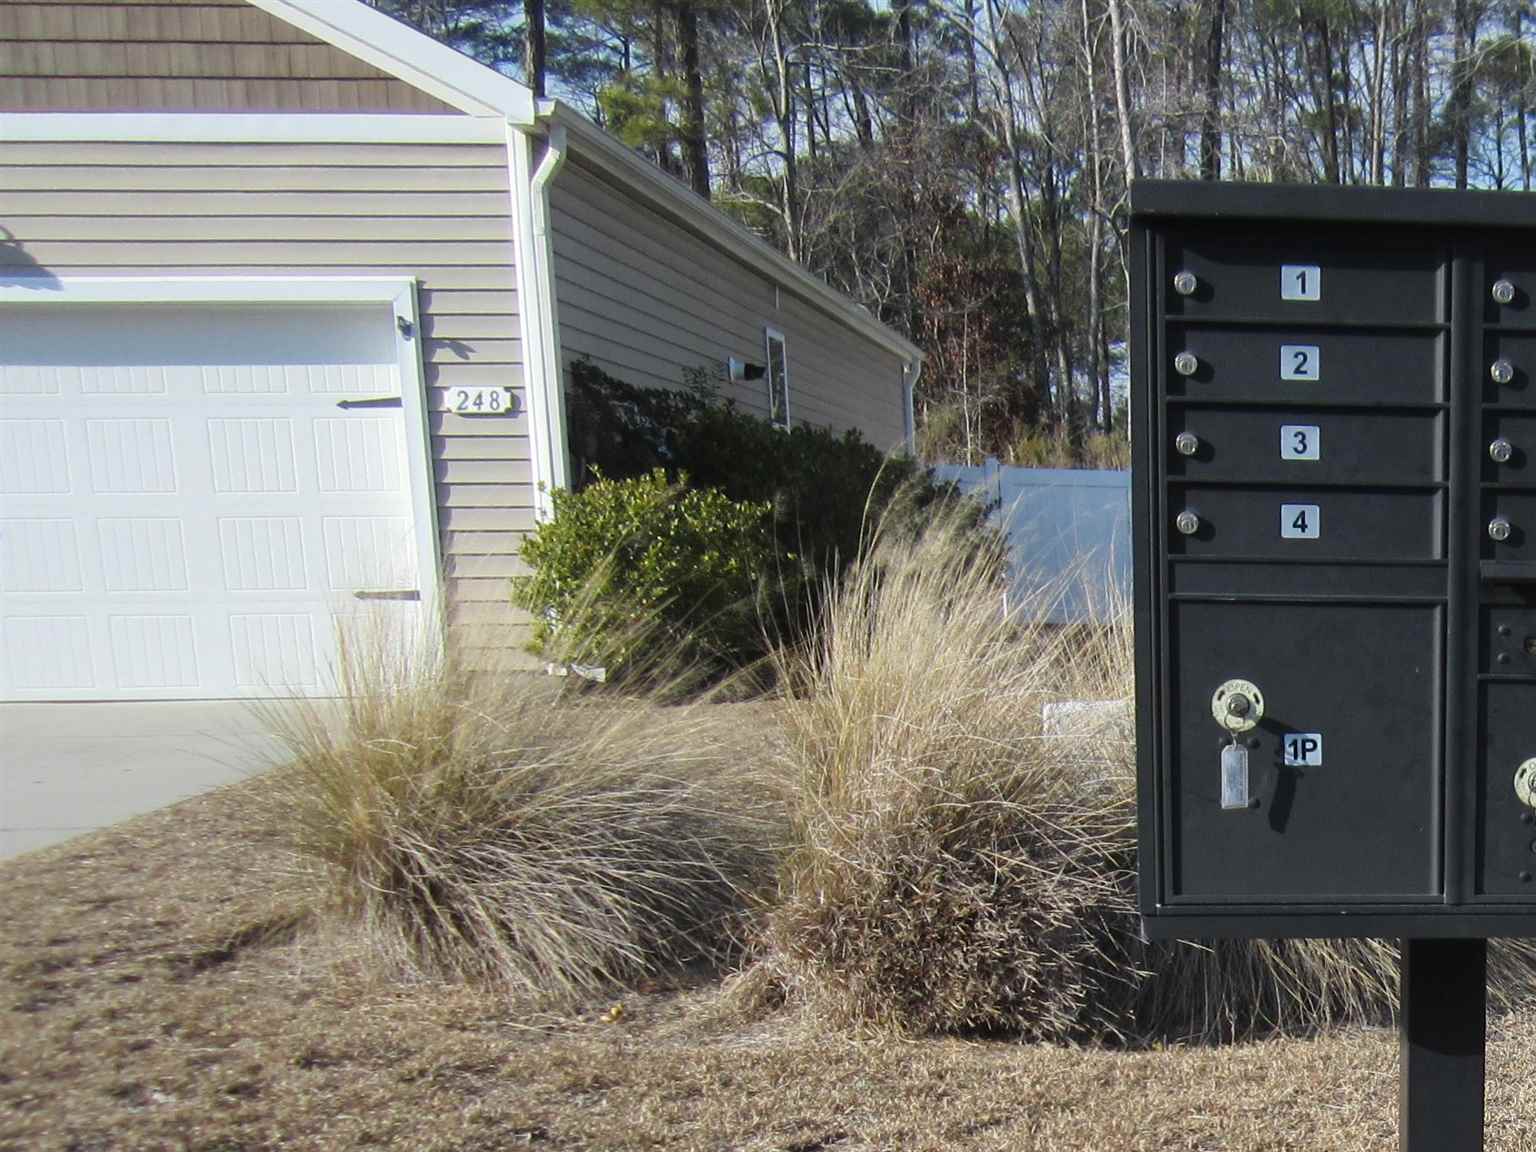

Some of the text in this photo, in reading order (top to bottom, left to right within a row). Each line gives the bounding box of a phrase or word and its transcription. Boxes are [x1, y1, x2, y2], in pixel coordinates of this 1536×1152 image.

[1295, 270, 1307, 295] 1
[1293, 351, 1308, 375] 2
[456, 390, 501, 411] 248
[1292, 430, 1308, 455] 3
[1292, 509, 1309, 534] 4
[1288, 737, 1319, 762] 1P
